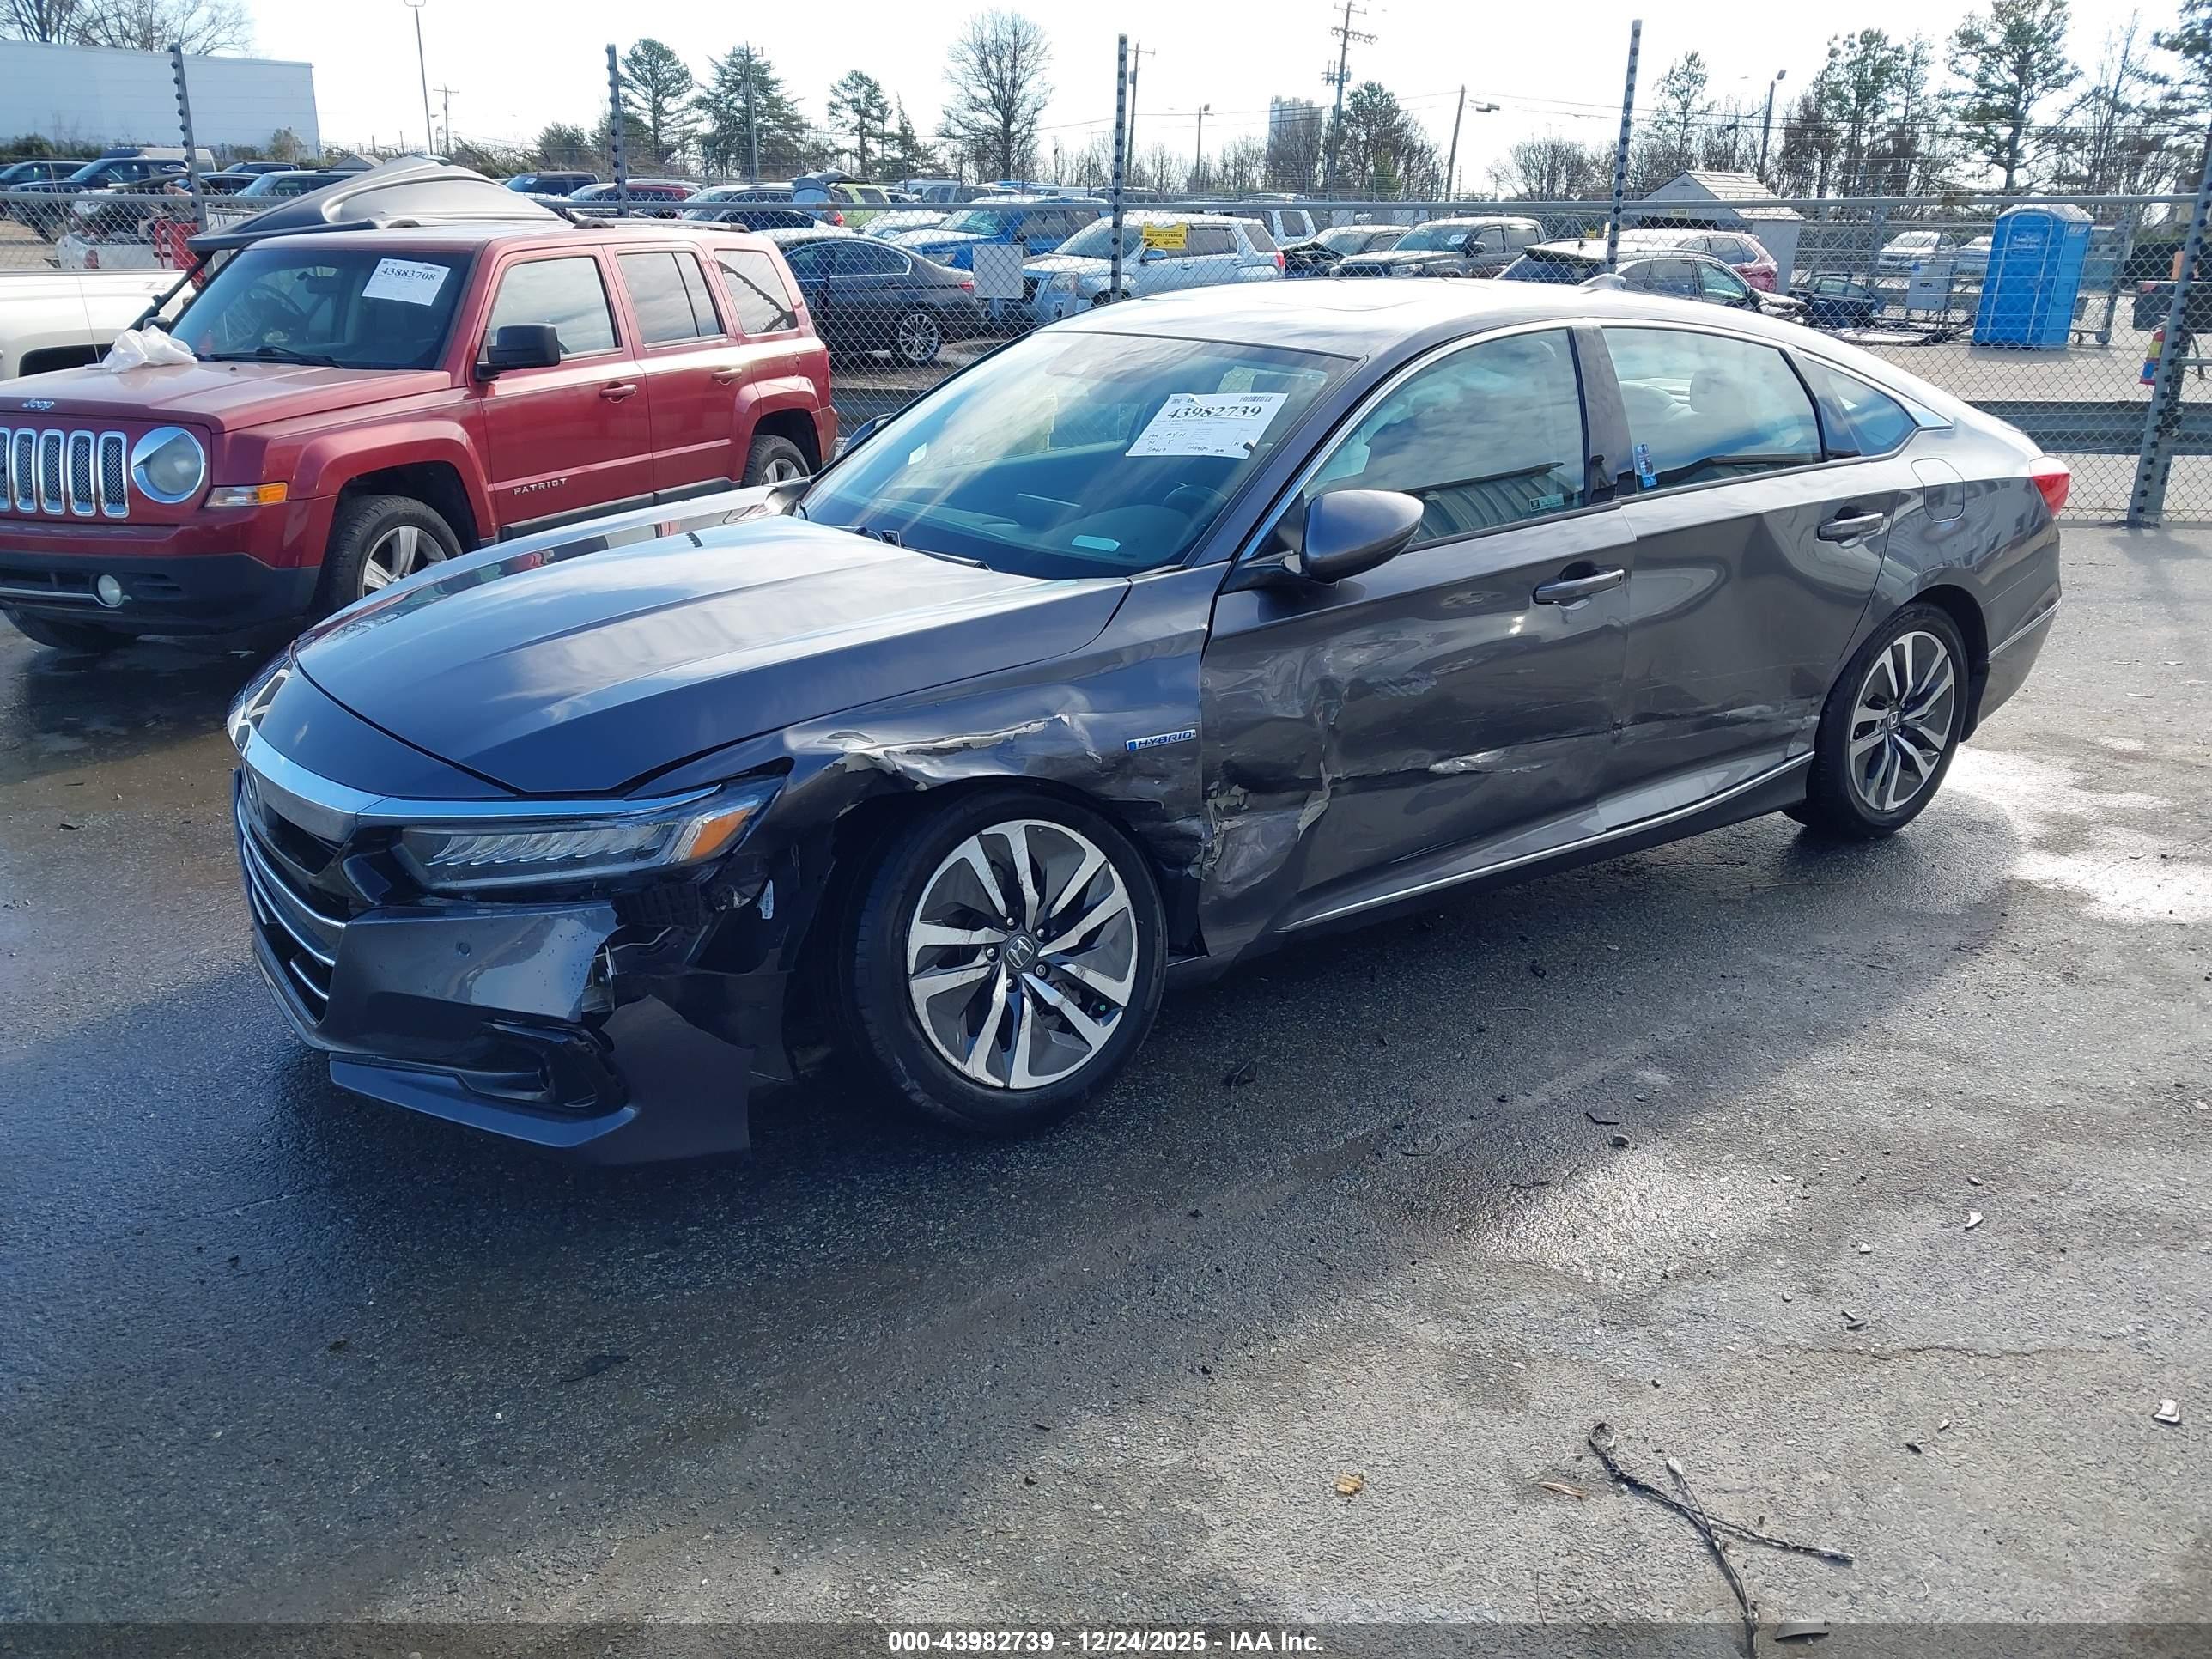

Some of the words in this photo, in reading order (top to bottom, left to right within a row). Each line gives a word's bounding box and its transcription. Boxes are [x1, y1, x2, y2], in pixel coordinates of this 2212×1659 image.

[381, 267, 436, 281] 43883708
[21, 398, 55, 410] Jeep
[1167, 405, 1262, 419] 43982739
[514, 477, 568, 495] PATRIOT
[1139, 732, 1192, 748] HYBRID
